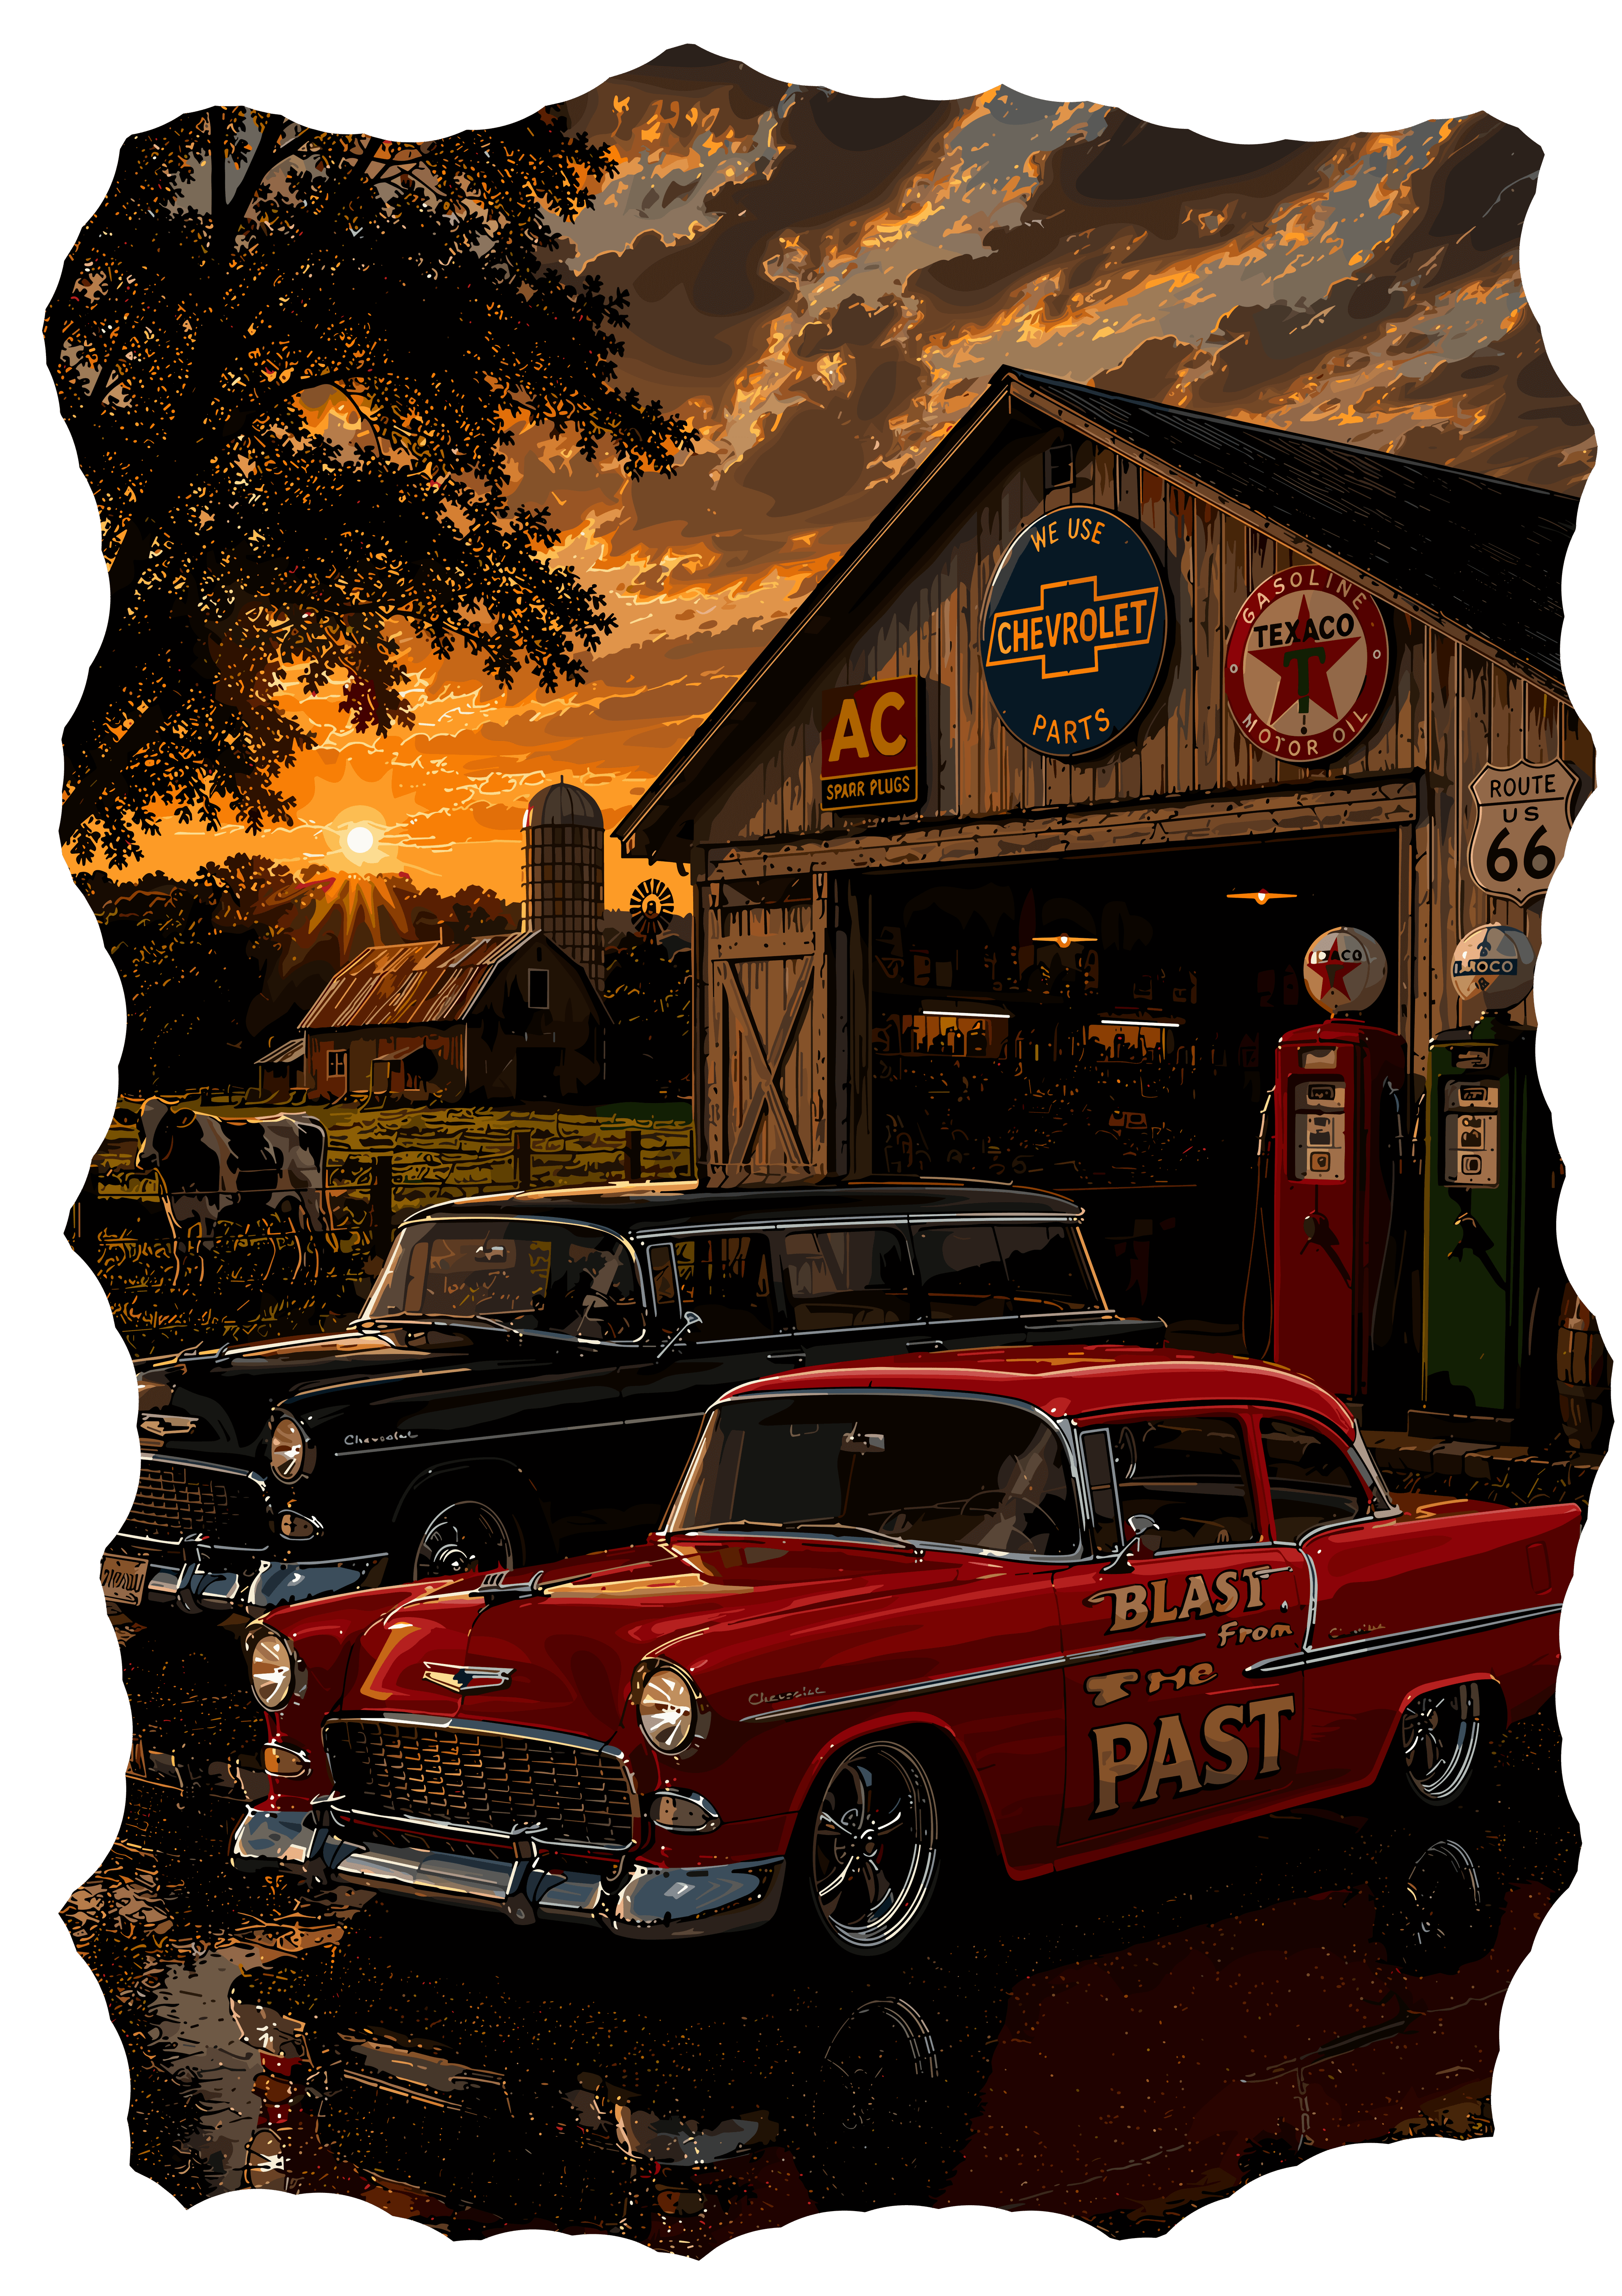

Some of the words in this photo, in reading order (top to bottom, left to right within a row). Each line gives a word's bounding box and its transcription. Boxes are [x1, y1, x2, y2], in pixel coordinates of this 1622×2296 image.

[1031, 521, 1059, 552] WE
[1068, 518, 1105, 544] USE
[1242, 569, 1367, 624] GASOLINE
[997, 600, 1147, 654] CHEVROLET
[1253, 613, 1355, 648] TEXACO
[828, 692, 907, 762] AC
[1032, 708, 1110, 744] PARTS
[1242, 713, 1318, 756] MOTOR
[1333, 711, 1368, 744] OIL
[870, 775, 910, 795] PLUGS
[1490, 774, 1556, 798] ROUTE
[1503, 806, 1540, 823] US
[1486, 824, 1556, 882] 66
[1086, 1566, 1270, 1633] BLAST
[1089, 1693, 1295, 1818] PAST
